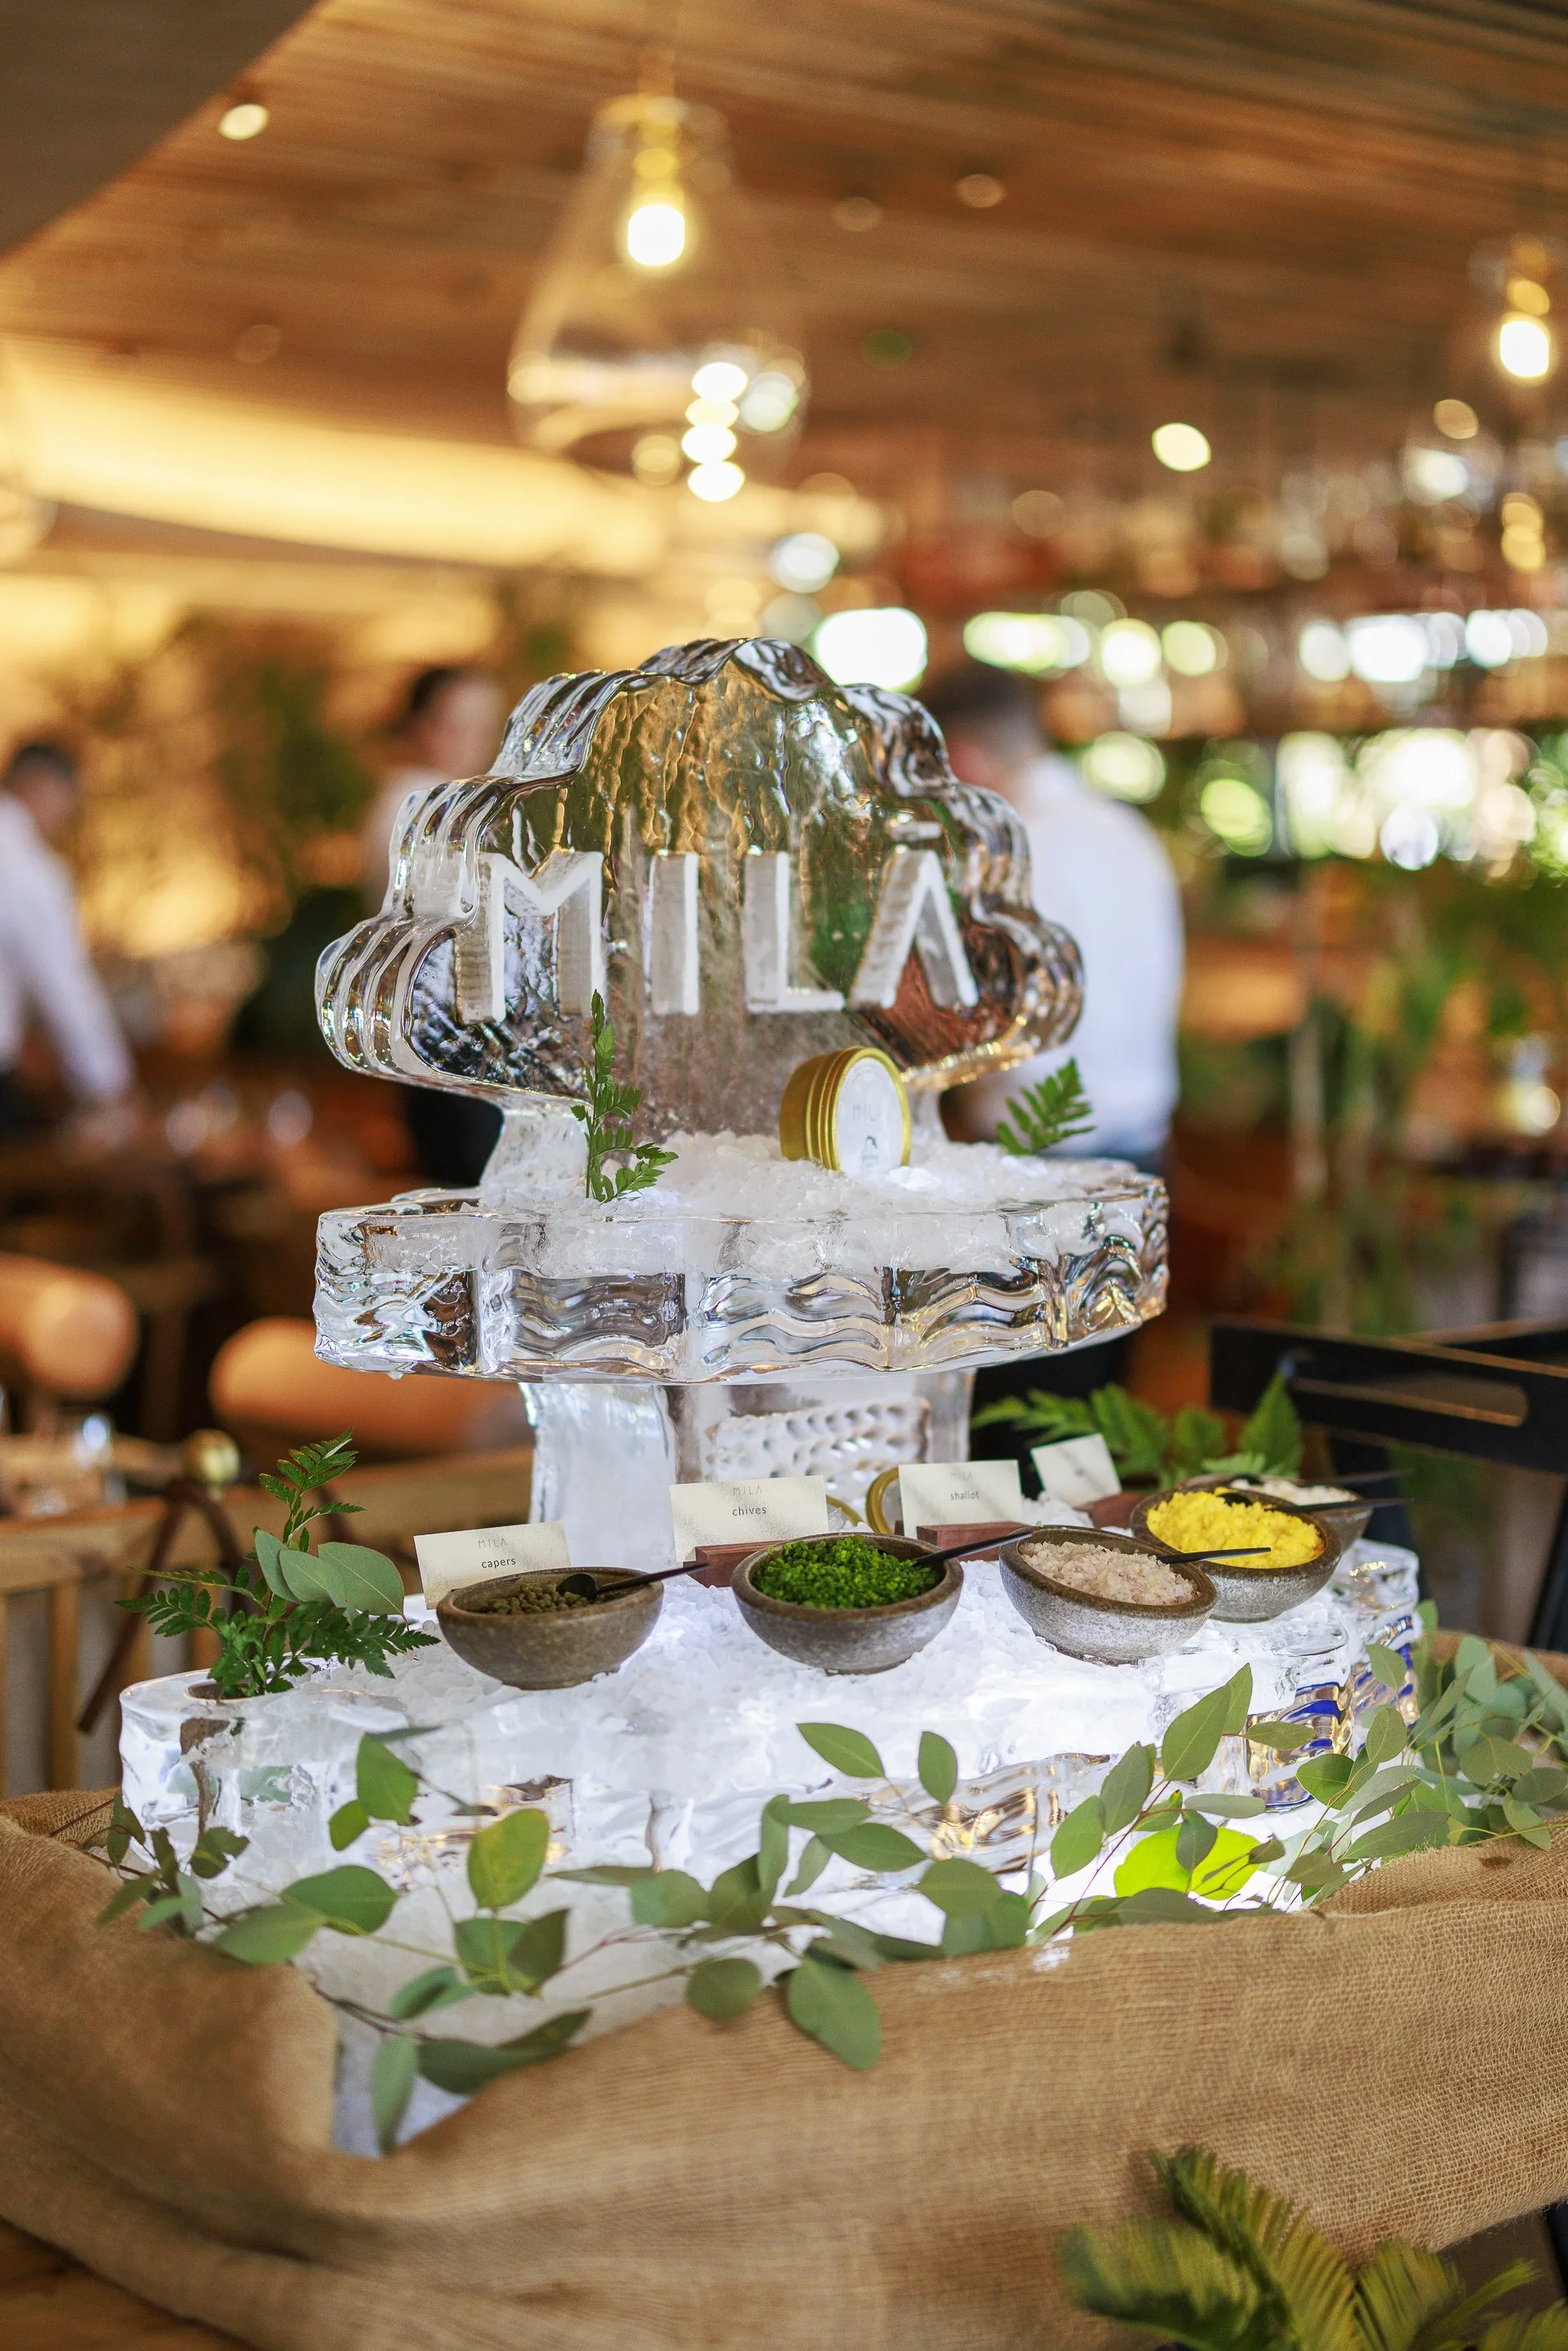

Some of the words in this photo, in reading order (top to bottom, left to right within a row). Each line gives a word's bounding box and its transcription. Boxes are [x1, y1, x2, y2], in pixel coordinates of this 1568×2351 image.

[949, 1489, 980, 1501] shallot
[732, 1506, 768, 1516] chives
[480, 1557, 517, 1570] capers
